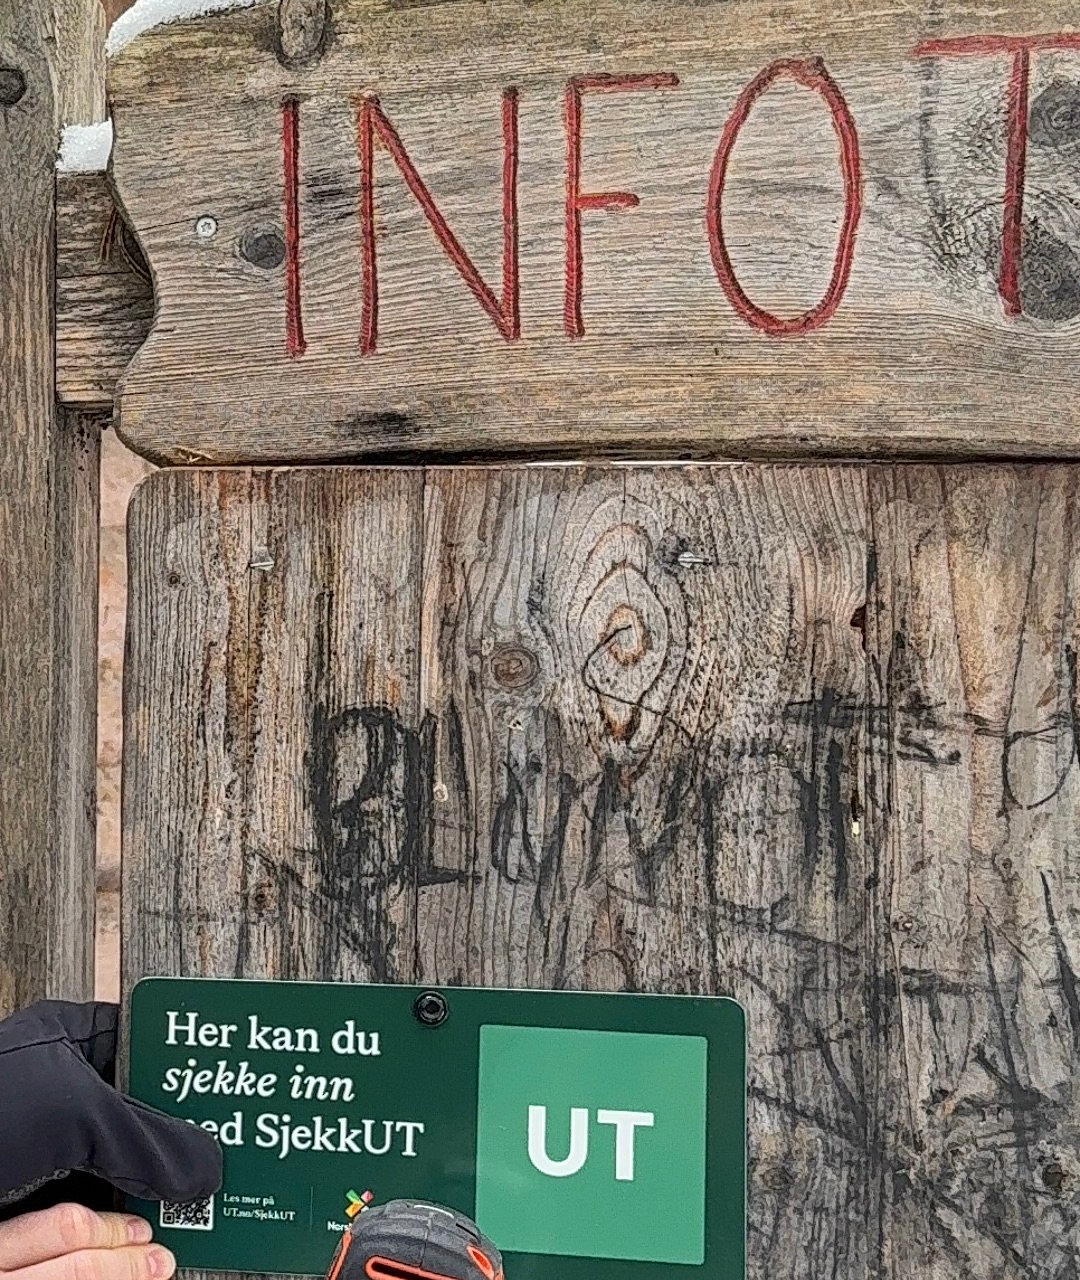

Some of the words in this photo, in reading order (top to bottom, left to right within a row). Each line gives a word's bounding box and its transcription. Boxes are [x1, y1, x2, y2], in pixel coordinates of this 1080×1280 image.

[165, 1011, 238, 1048] Her
[247, 1015, 320, 1053] kan
[331, 1020, 381, 1056] du
[162, 1058, 278, 1103] sjekke
[289, 1064, 355, 1102] inn
[184, 1111, 244, 1146] ed
[256, 1113, 425, 1159] SjekkUT
[527, 1105, 655, 1181] UT
[223, 1192, 240, 1203] Les
[241, 1196, 261, 1205] mer
[262, 1195, 275, 1207] på
